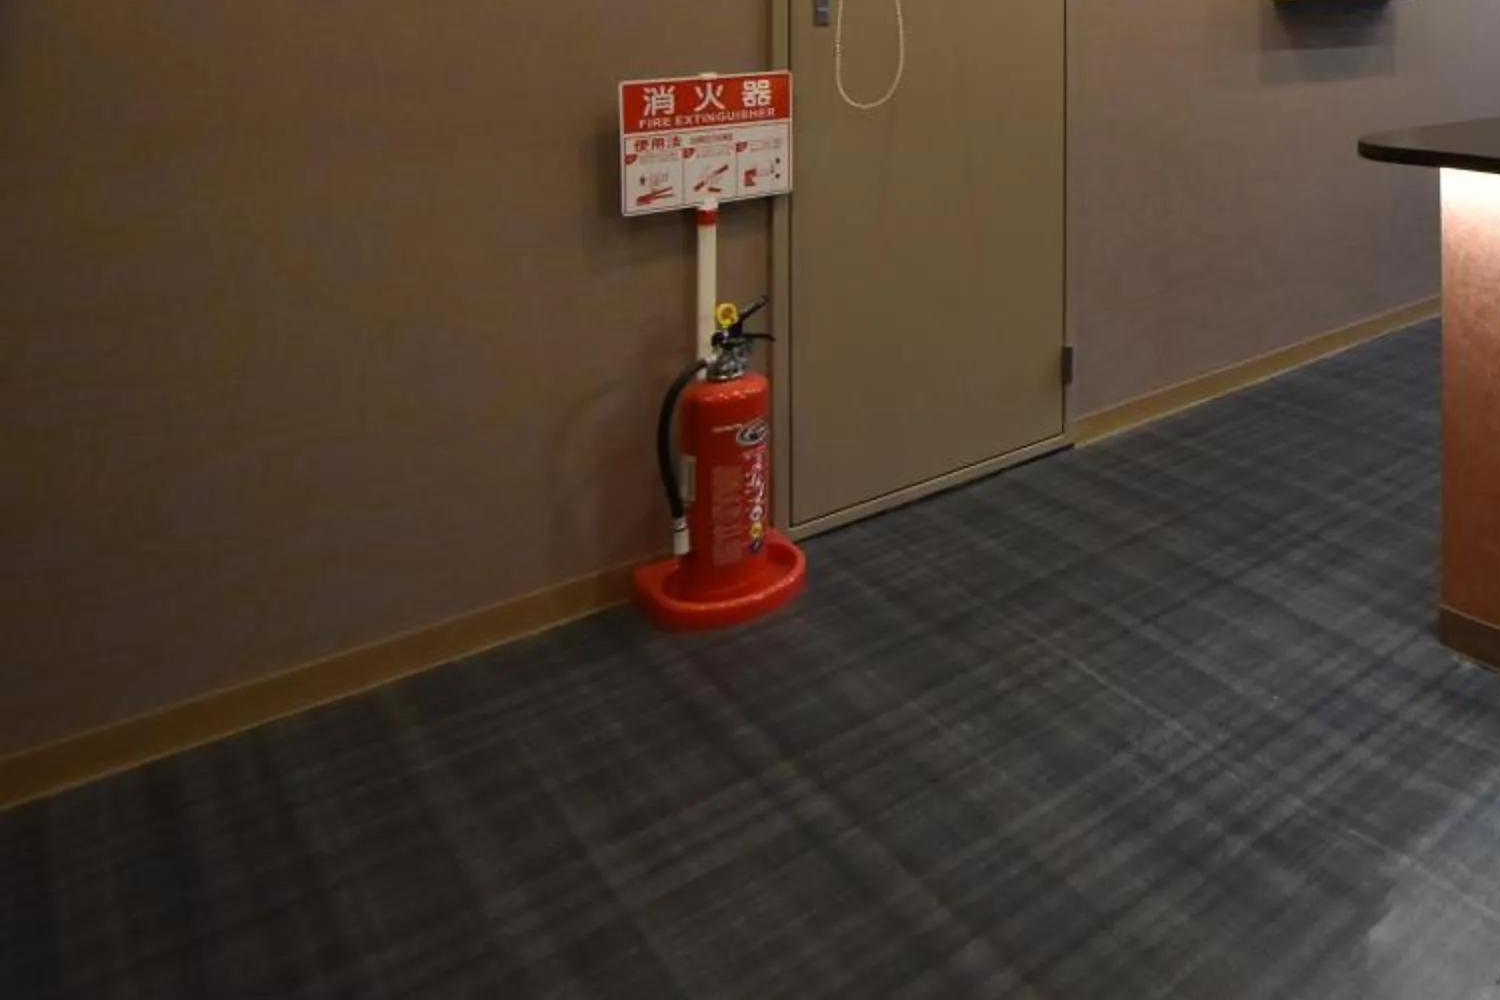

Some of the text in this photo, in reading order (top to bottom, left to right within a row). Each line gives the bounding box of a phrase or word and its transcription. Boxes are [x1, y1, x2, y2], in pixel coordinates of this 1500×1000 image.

[643, 79, 772, 116] 消火器
[638, 107, 776, 129] FIRE EXTINGUISHER
